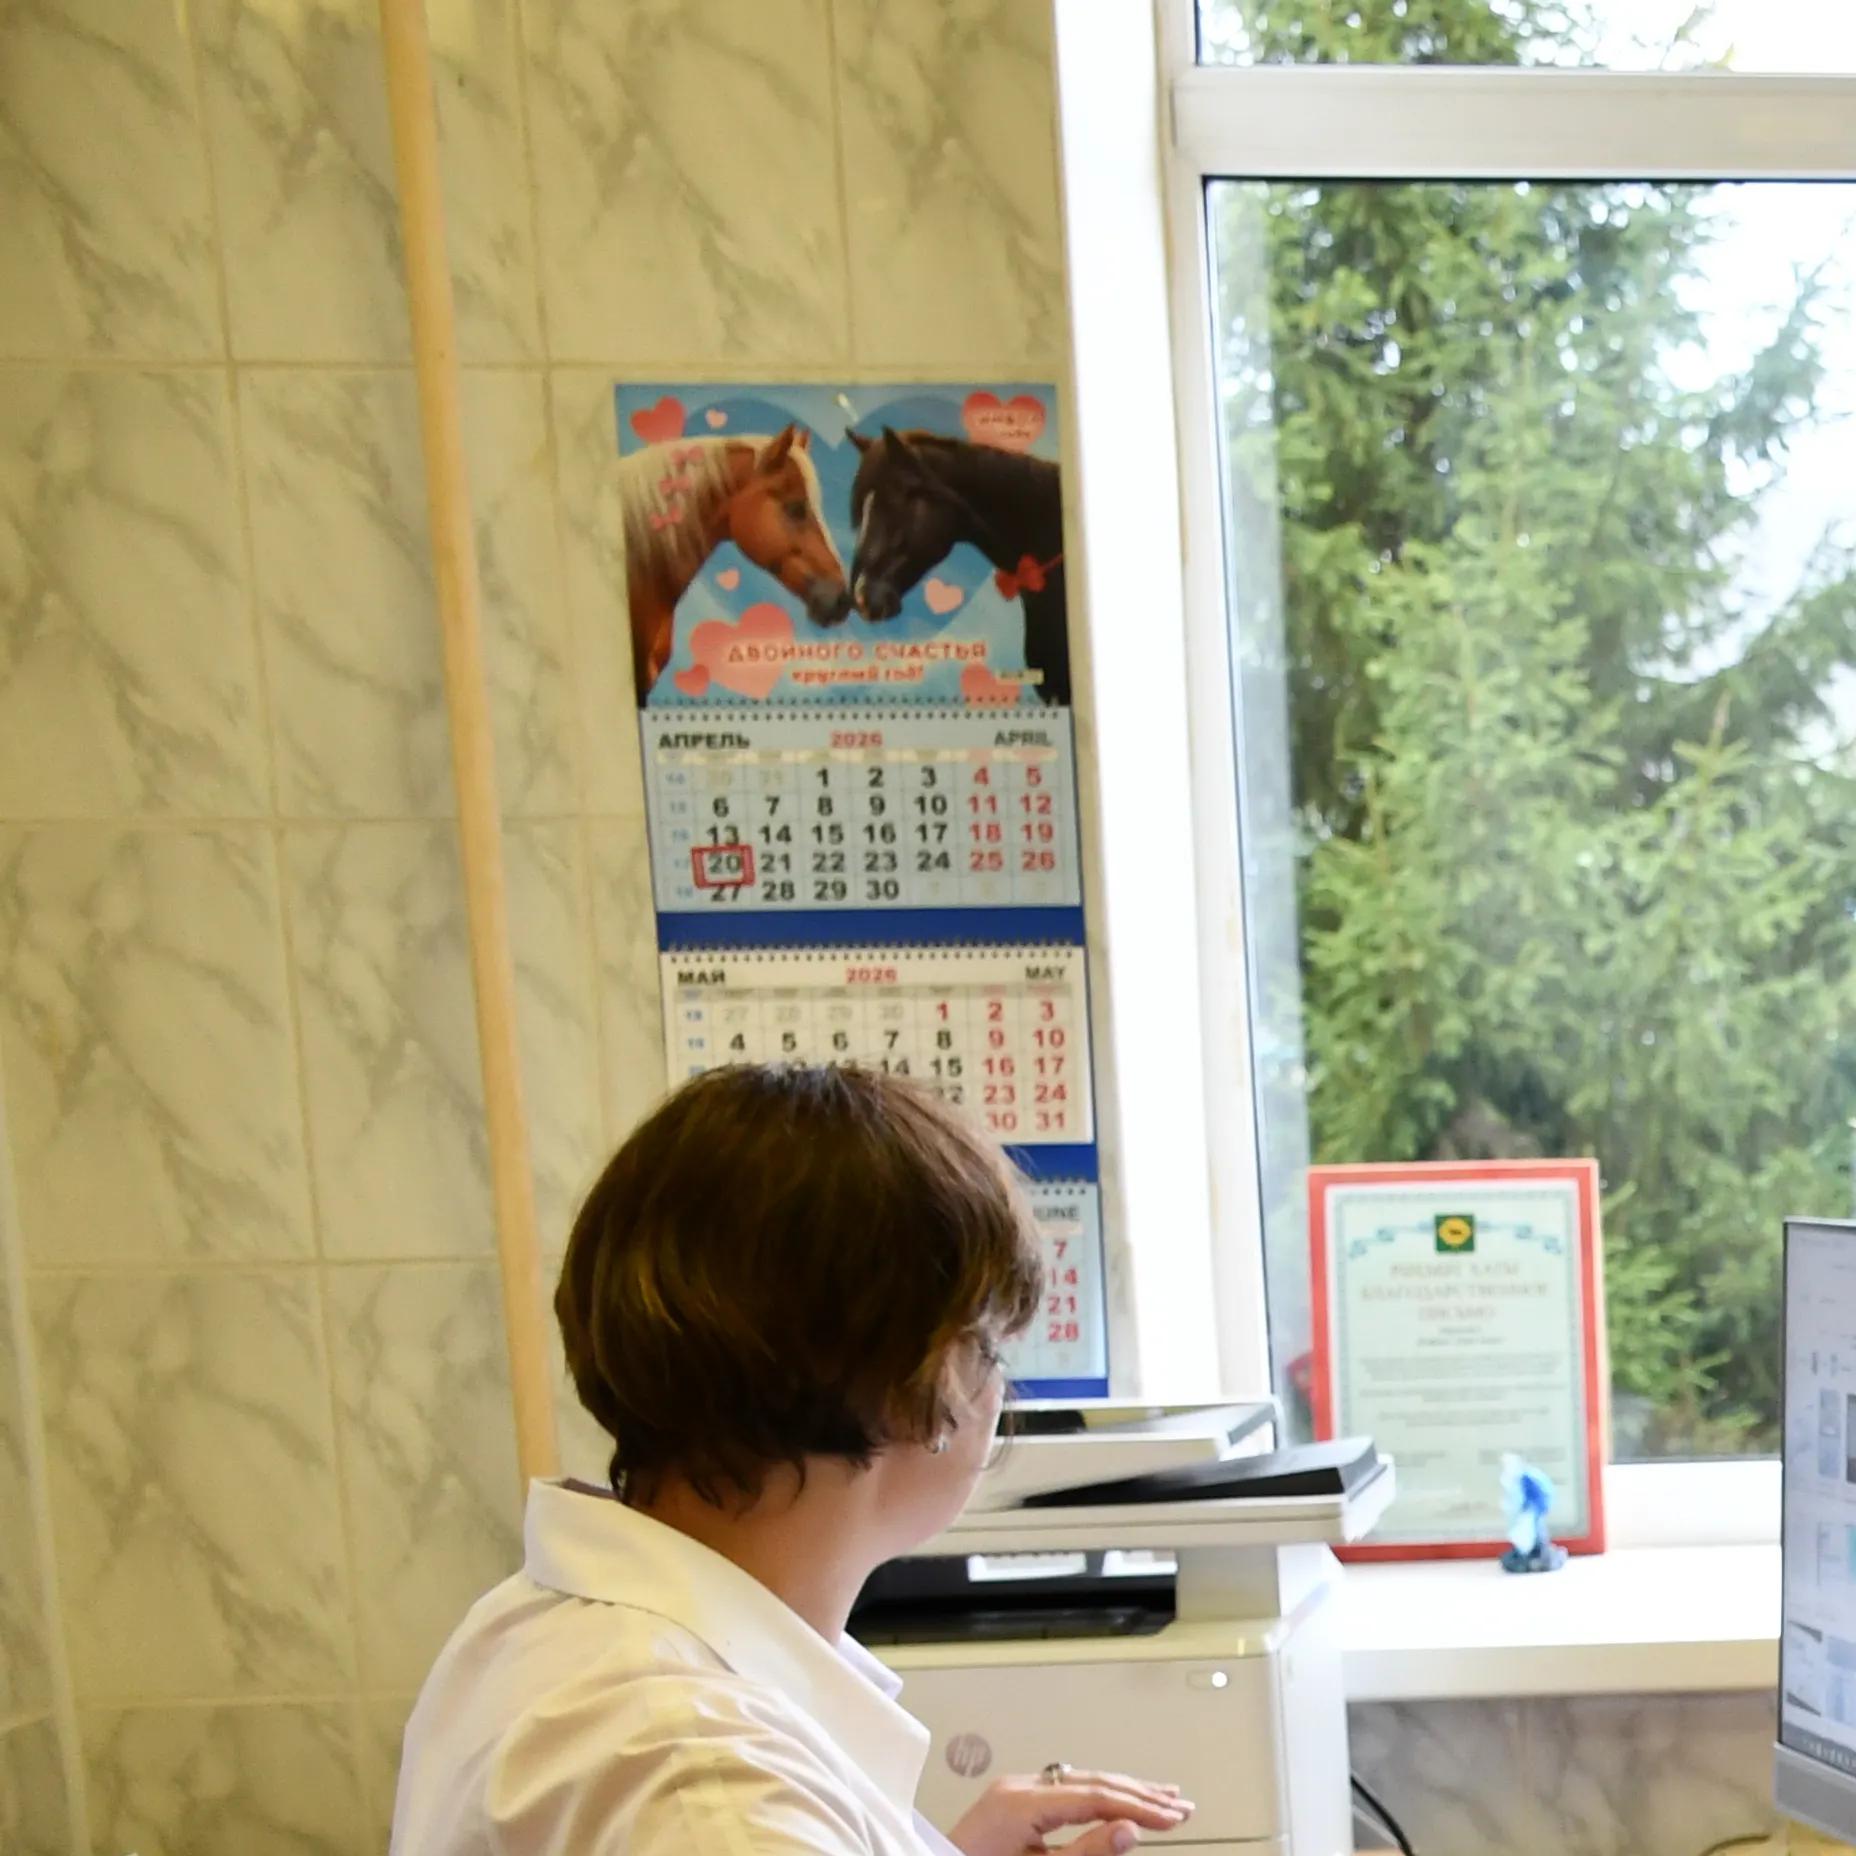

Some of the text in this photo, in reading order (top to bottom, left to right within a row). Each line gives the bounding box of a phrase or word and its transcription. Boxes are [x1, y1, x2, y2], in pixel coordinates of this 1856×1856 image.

[659, 731, 750, 748] АПРЕЛЬ
[831, 731, 882, 748] 2026
[994, 730, 1053, 746] APRIL
[816, 766, 829, 788] 1
[868, 766, 884, 788] 2
[921, 765, 936, 787] 3
[974, 766, 989, 786] 4
[1026, 765, 1042, 787] 5
[713, 796, 729, 817] 6
[765, 796, 780, 816] 7
[817, 796, 833, 816] 8
[869, 795, 886, 816] 9
[914, 794, 947, 815] 10
[968, 794, 997, 815] 11
[1019, 793, 1052, 815] 12
[707, 825, 739, 844] 13
[758, 824, 792, 844] 14
[812, 823, 844, 845] 15
[863, 823, 896, 844] 16
[915, 823, 948, 844] 17
[969, 823, 1001, 843] 18
[1021, 823, 1053, 843] 19
[708, 853, 740, 874] 20
[760, 853, 791, 873] 21
[812, 852, 845, 873] 22
[865, 852, 897, 873] 23
[917, 852, 950, 873] 24
[970, 852, 1003, 872] 25
[1022, 852, 1055, 872] 26
[711, 884, 741, 902] 27
[762, 880, 795, 901] 28
[814, 880, 847, 901] 29
[866, 879, 899, 901] 30
[678, 969, 726, 984] МАЙ
[847, 968, 897, 983] 2026
[1025, 965, 1066, 979] MAY
[937, 1002, 949, 1022] 1
[988, 1001, 1003, 1022] 2
[1040, 1001, 1054, 1022] 3
[730, 1032, 745, 1052] 4
[782, 1032, 797, 1052] 5
[833, 1032, 849, 1051] 6
[884, 1030, 899, 1050] 7
[937, 1029, 952, 1050] 8
[988, 1028, 1004, 1049] 9
[1033, 1028, 1065, 1049] 10
[881, 1057, 910, 1076] 14
[930, 1056, 963, 1078] 15
[982, 1056, 1015, 1077] 16
[1034, 1056, 1064, 1076] 17
[984, 1084, 1016, 1105] 23
[1034, 1083, 1067, 1104] 24
[985, 1110, 1066, 1132] 30 31
[1053, 1240, 1067, 1260] 7
[1050, 1268, 1078, 1288] 14
[1048, 1297, 1077, 1316] 21
[949, 1735, 988, 1778] hp
